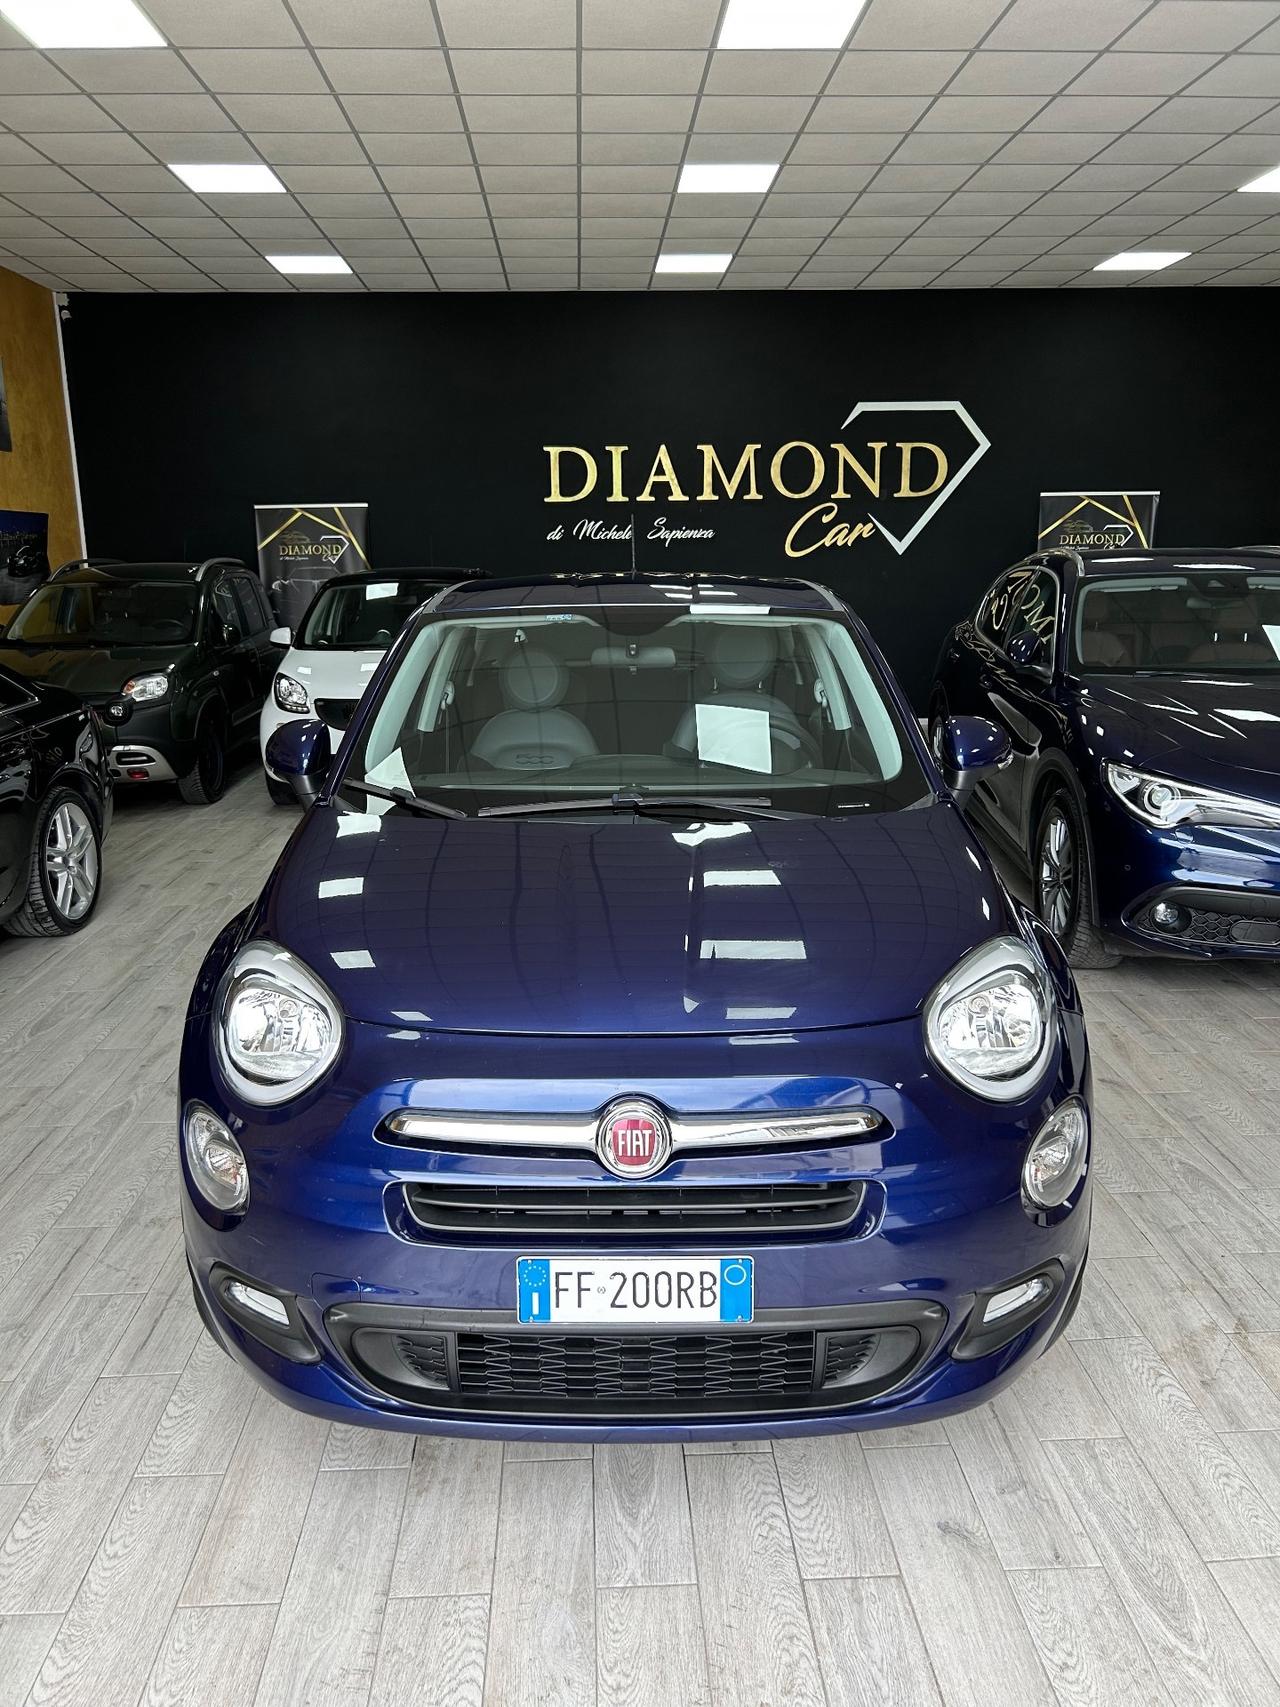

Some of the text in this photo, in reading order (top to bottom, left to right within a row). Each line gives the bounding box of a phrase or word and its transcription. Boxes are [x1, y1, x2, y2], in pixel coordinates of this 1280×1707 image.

[543, 441, 949, 503] DIAMOND
[546, 524, 565, 541] di
[647, 516, 716, 548] Sapienza
[784, 502, 876, 558] Car
[1059, 533, 1125, 545] DIAMOND
[279, 544, 341, 555] DIAMOND
[617, 1129, 653, 1157] FIAT
[554, 1270, 718, 1309] FF 200RB
